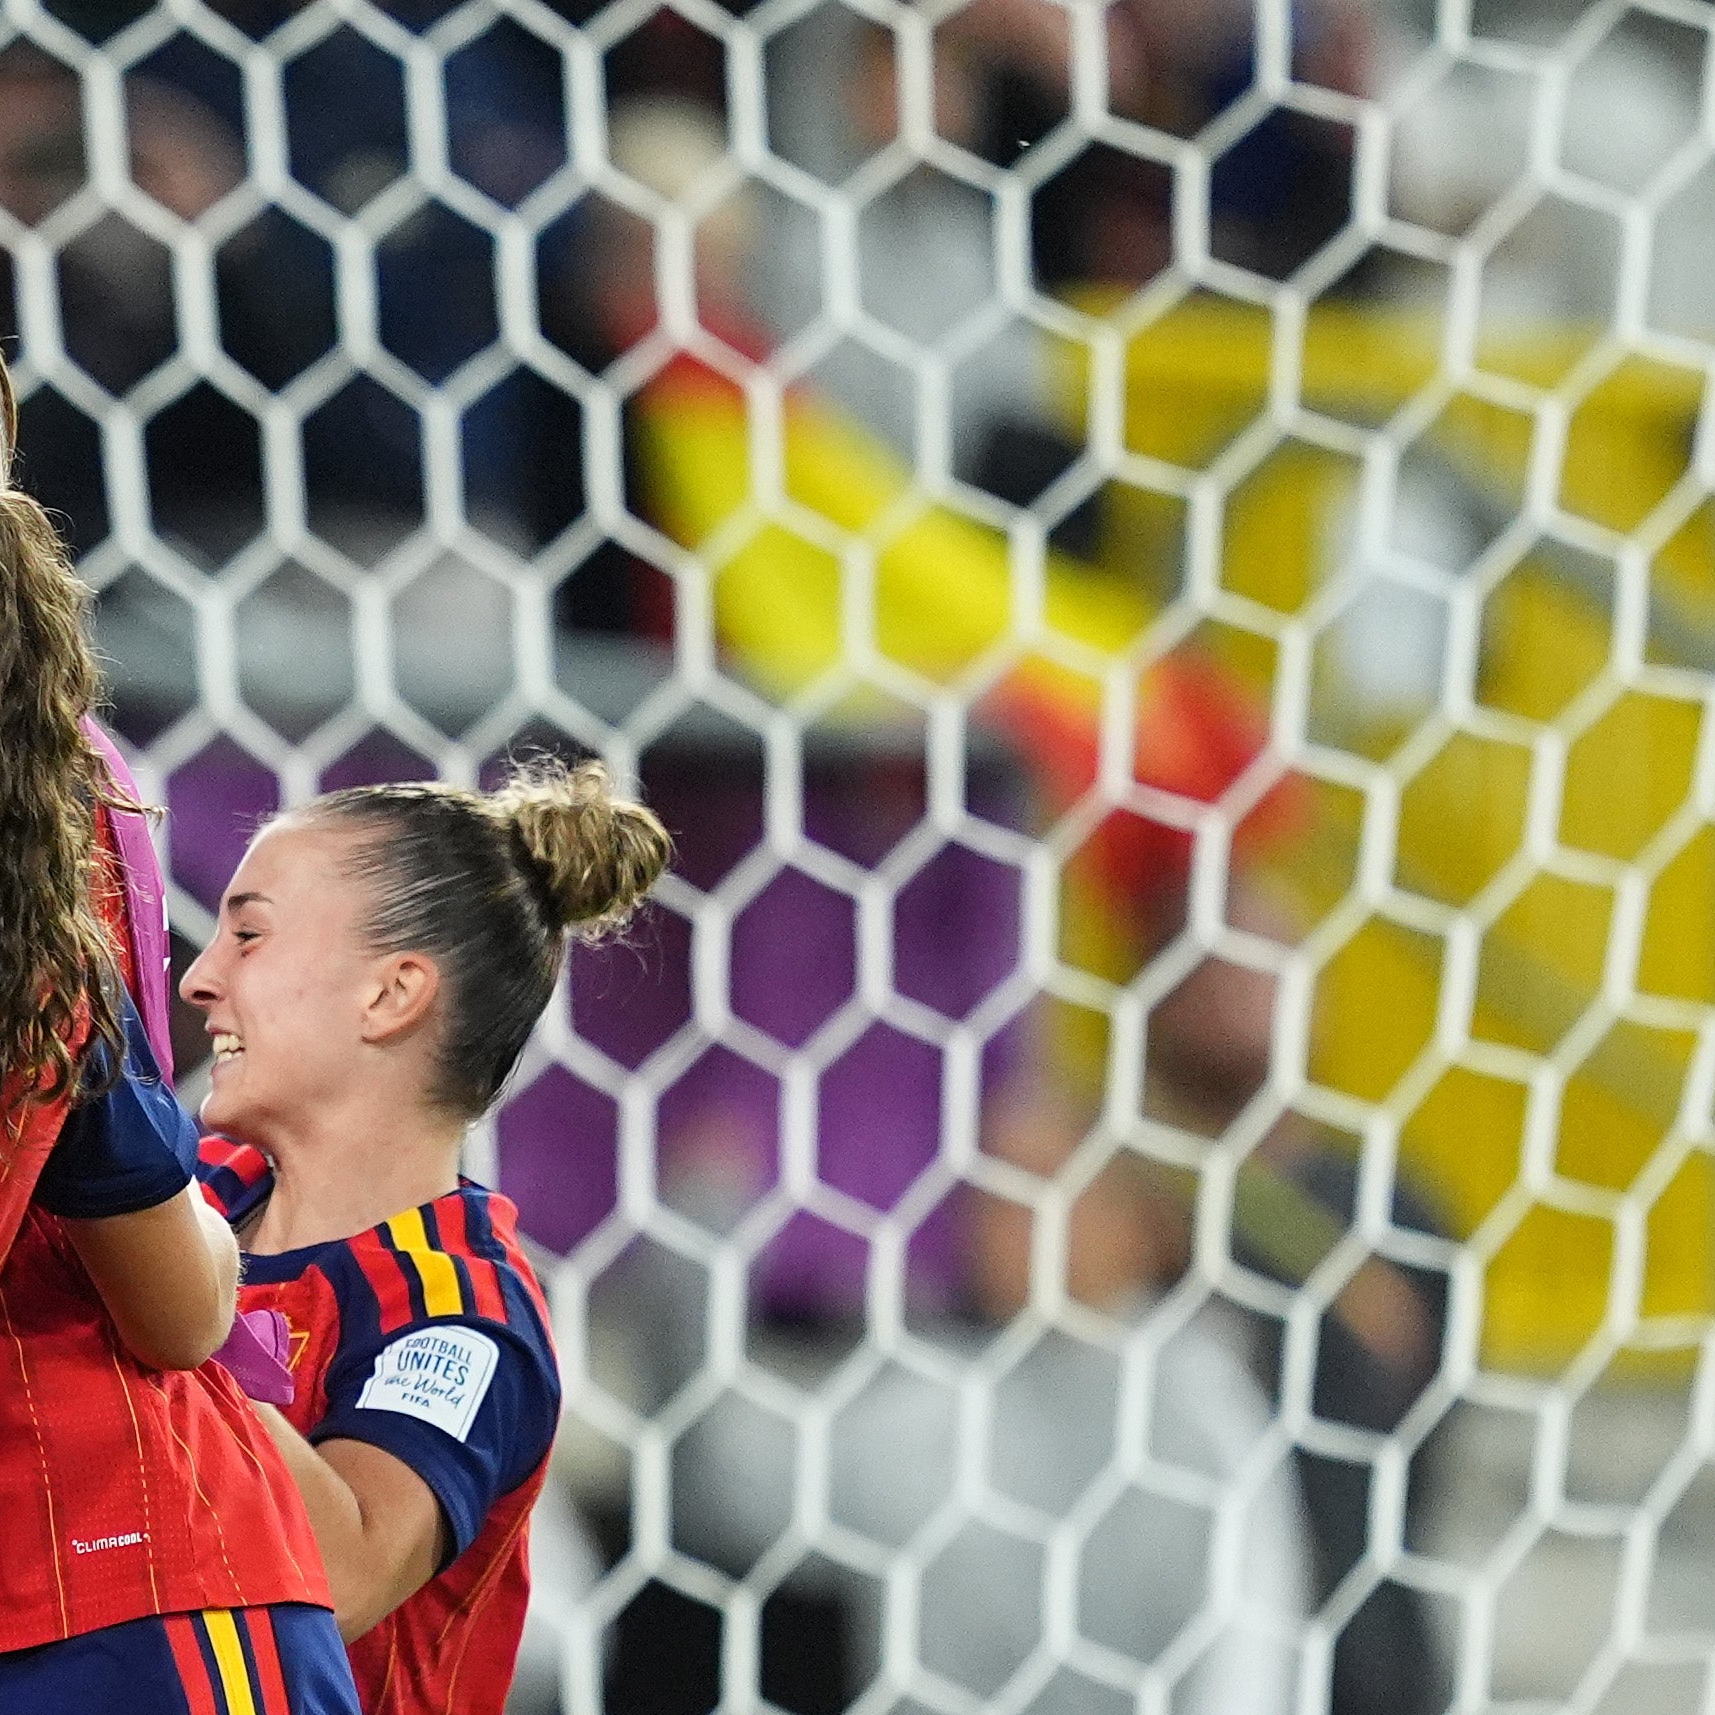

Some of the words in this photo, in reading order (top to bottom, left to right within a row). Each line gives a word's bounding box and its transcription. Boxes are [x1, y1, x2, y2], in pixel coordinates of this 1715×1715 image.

[405, 1336, 473, 1366] FOOTBALL
[397, 1350, 469, 1386] UNITES
[401, 1392, 431, 1408] FIFA
[413, 1374, 466, 1410] World
